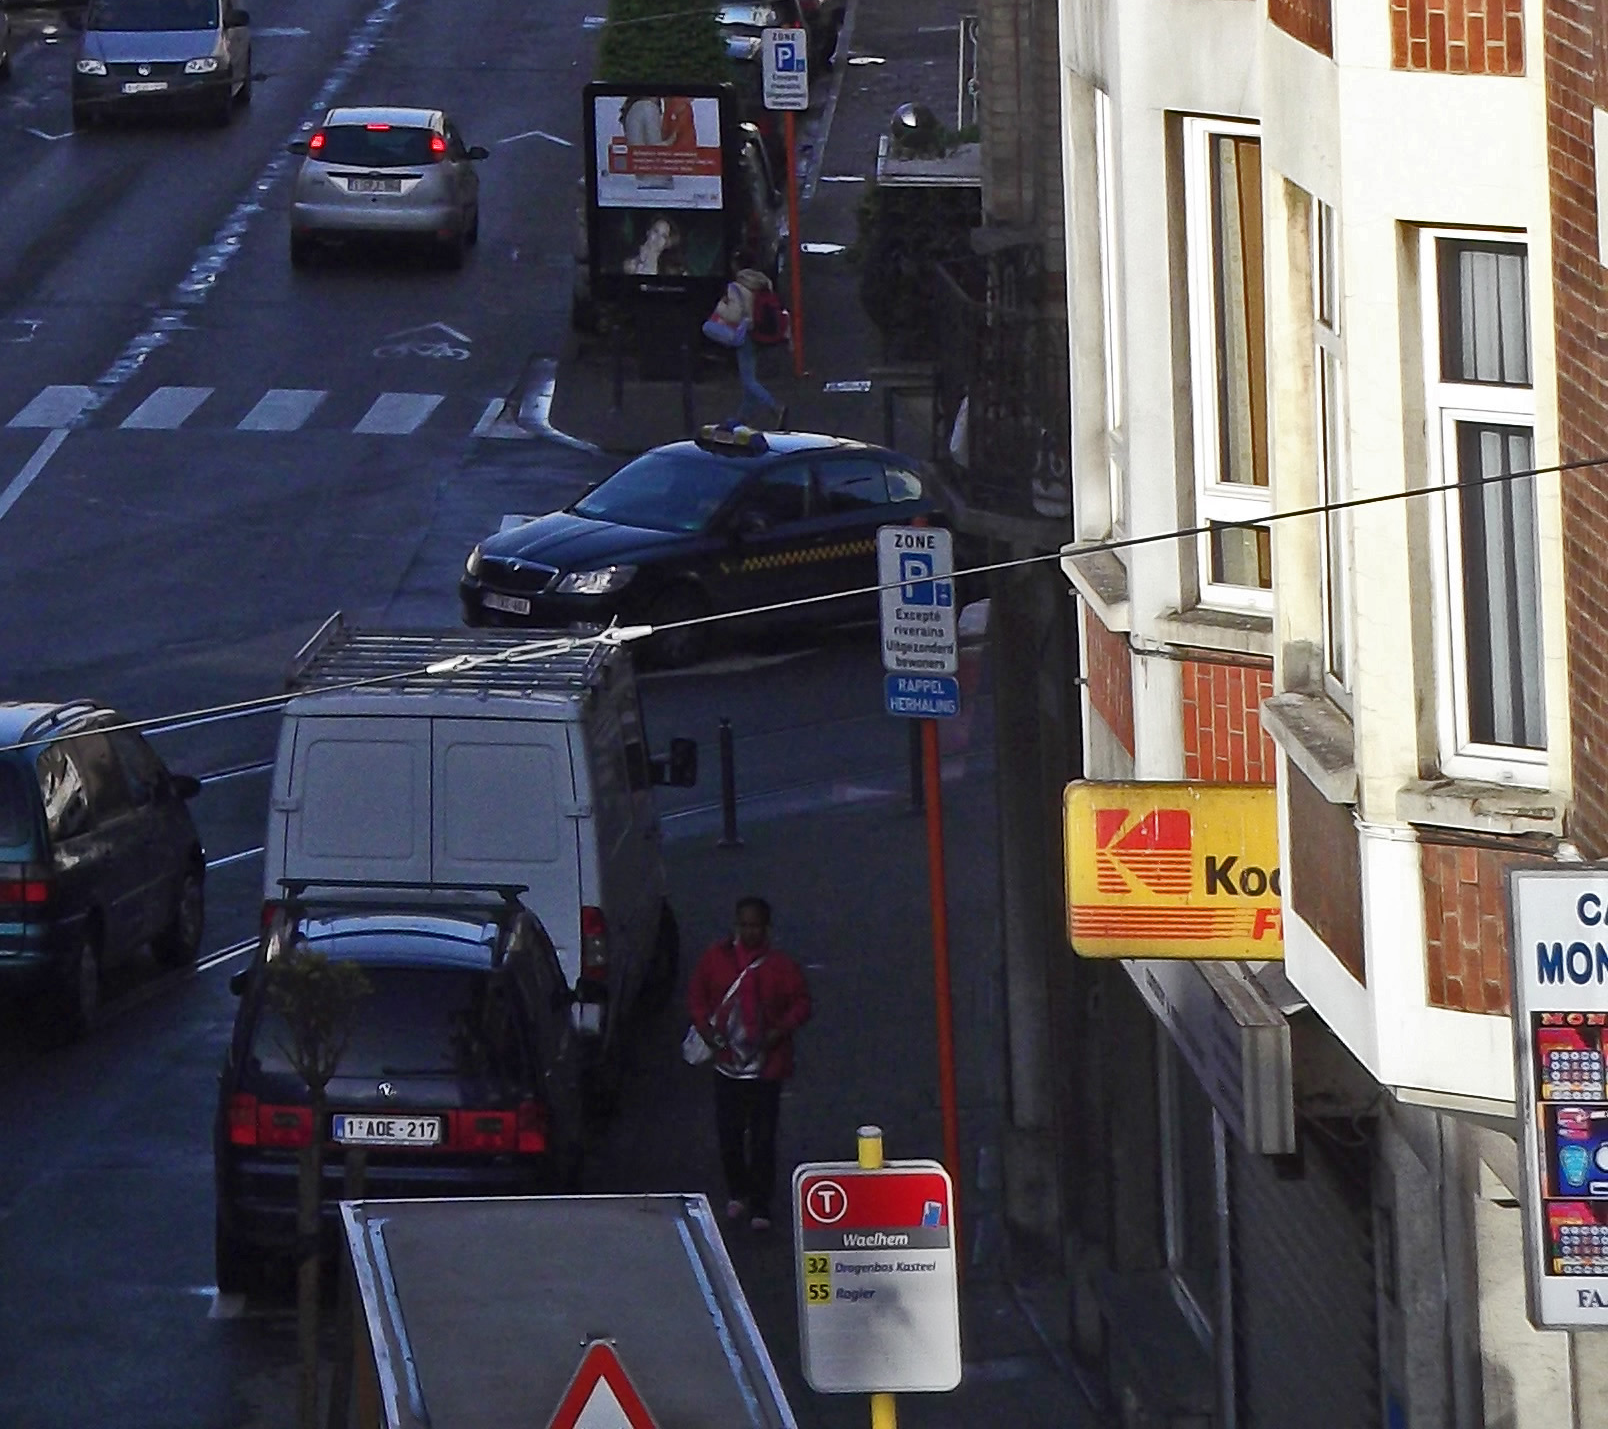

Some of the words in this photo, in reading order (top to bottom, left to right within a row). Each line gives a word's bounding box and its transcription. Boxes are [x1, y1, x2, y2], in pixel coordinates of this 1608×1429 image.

[894, 534, 935, 549] ZONE
[904, 560, 928, 598] P
[894, 625, 944, 638] riverains
[898, 678, 945, 694] RAPPEL
[890, 696, 956, 712] HERHALING
[1576, 892, 1608, 926] C
[1251, 908, 1283, 941] F
[842, 1231, 910, 1247] Waelhem
[808, 1257, 828, 1274] 32
[835, 1261, 893, 1276] Drogenbos
[896, 1260, 936, 1272] Kasteel
[809, 1284, 829, 1300] 55
[836, 1287, 876, 1302] Rogier
